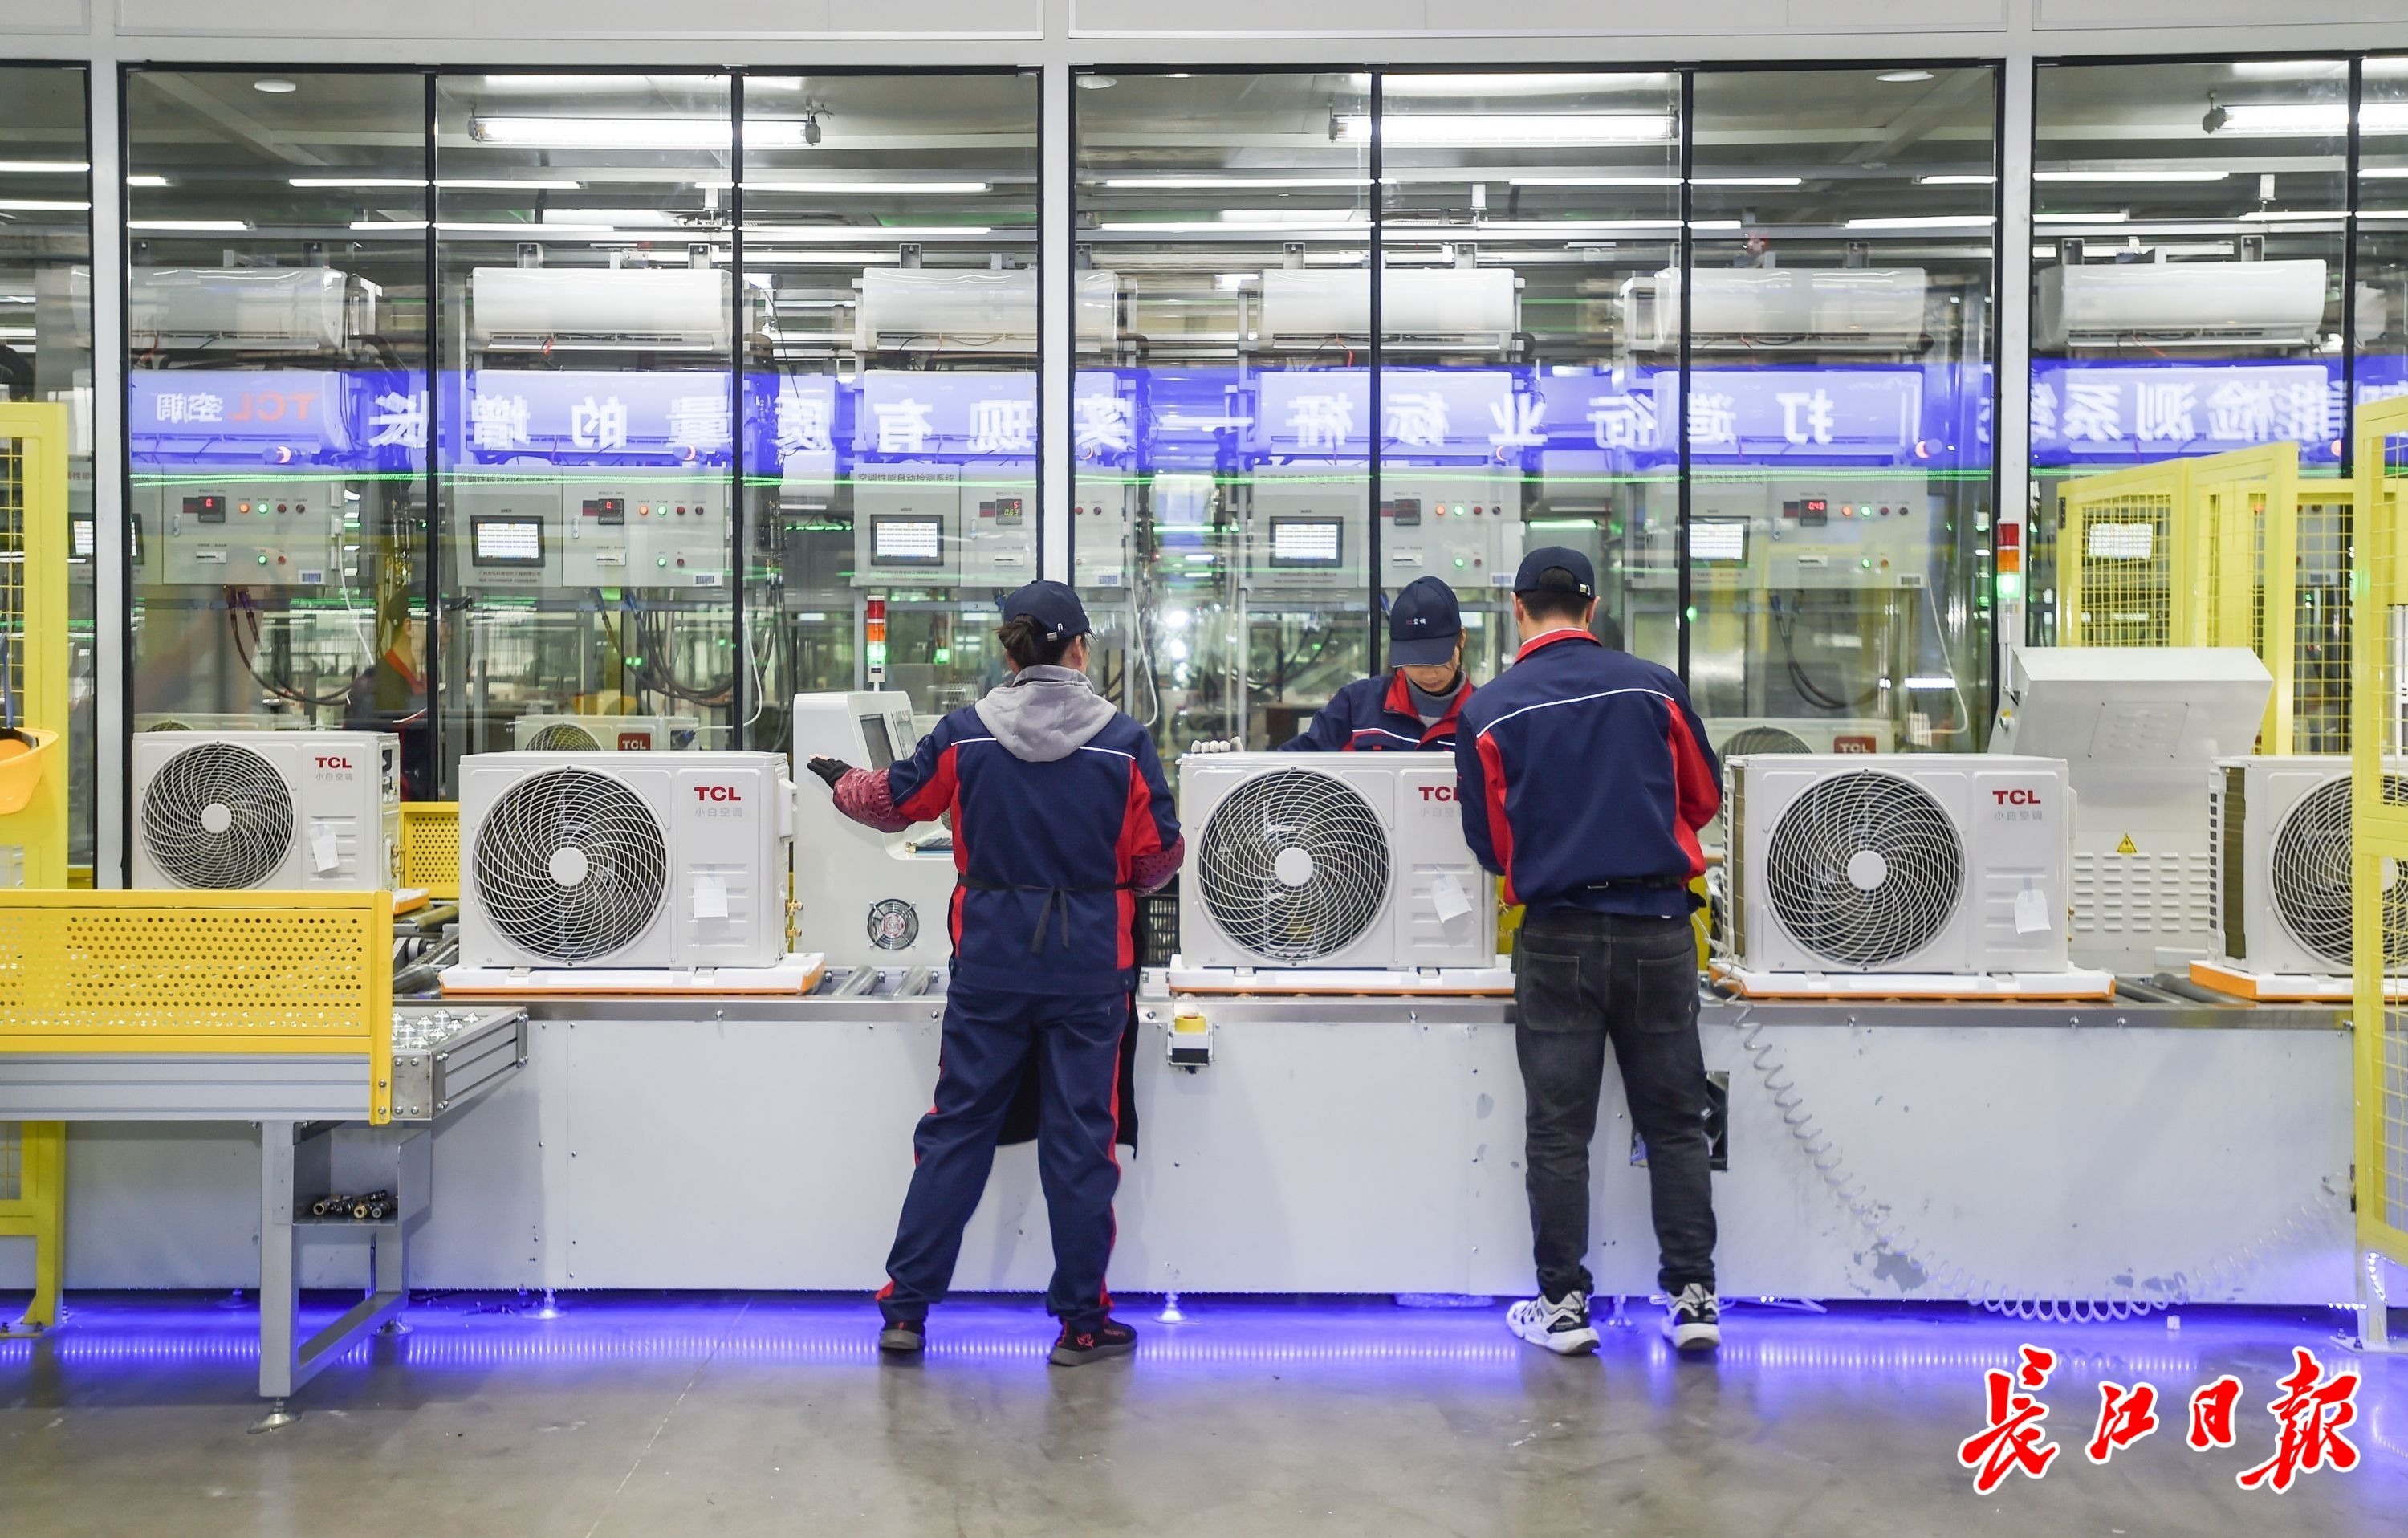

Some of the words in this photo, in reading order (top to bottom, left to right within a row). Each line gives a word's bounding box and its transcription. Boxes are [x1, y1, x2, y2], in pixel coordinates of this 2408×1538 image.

[622, 740, 647, 750] TCL
[1839, 743, 1871, 754] TCL
[315, 757, 352, 769] TCL
[694, 786, 742, 802] TCL
[1992, 790, 2041, 805] TCL
